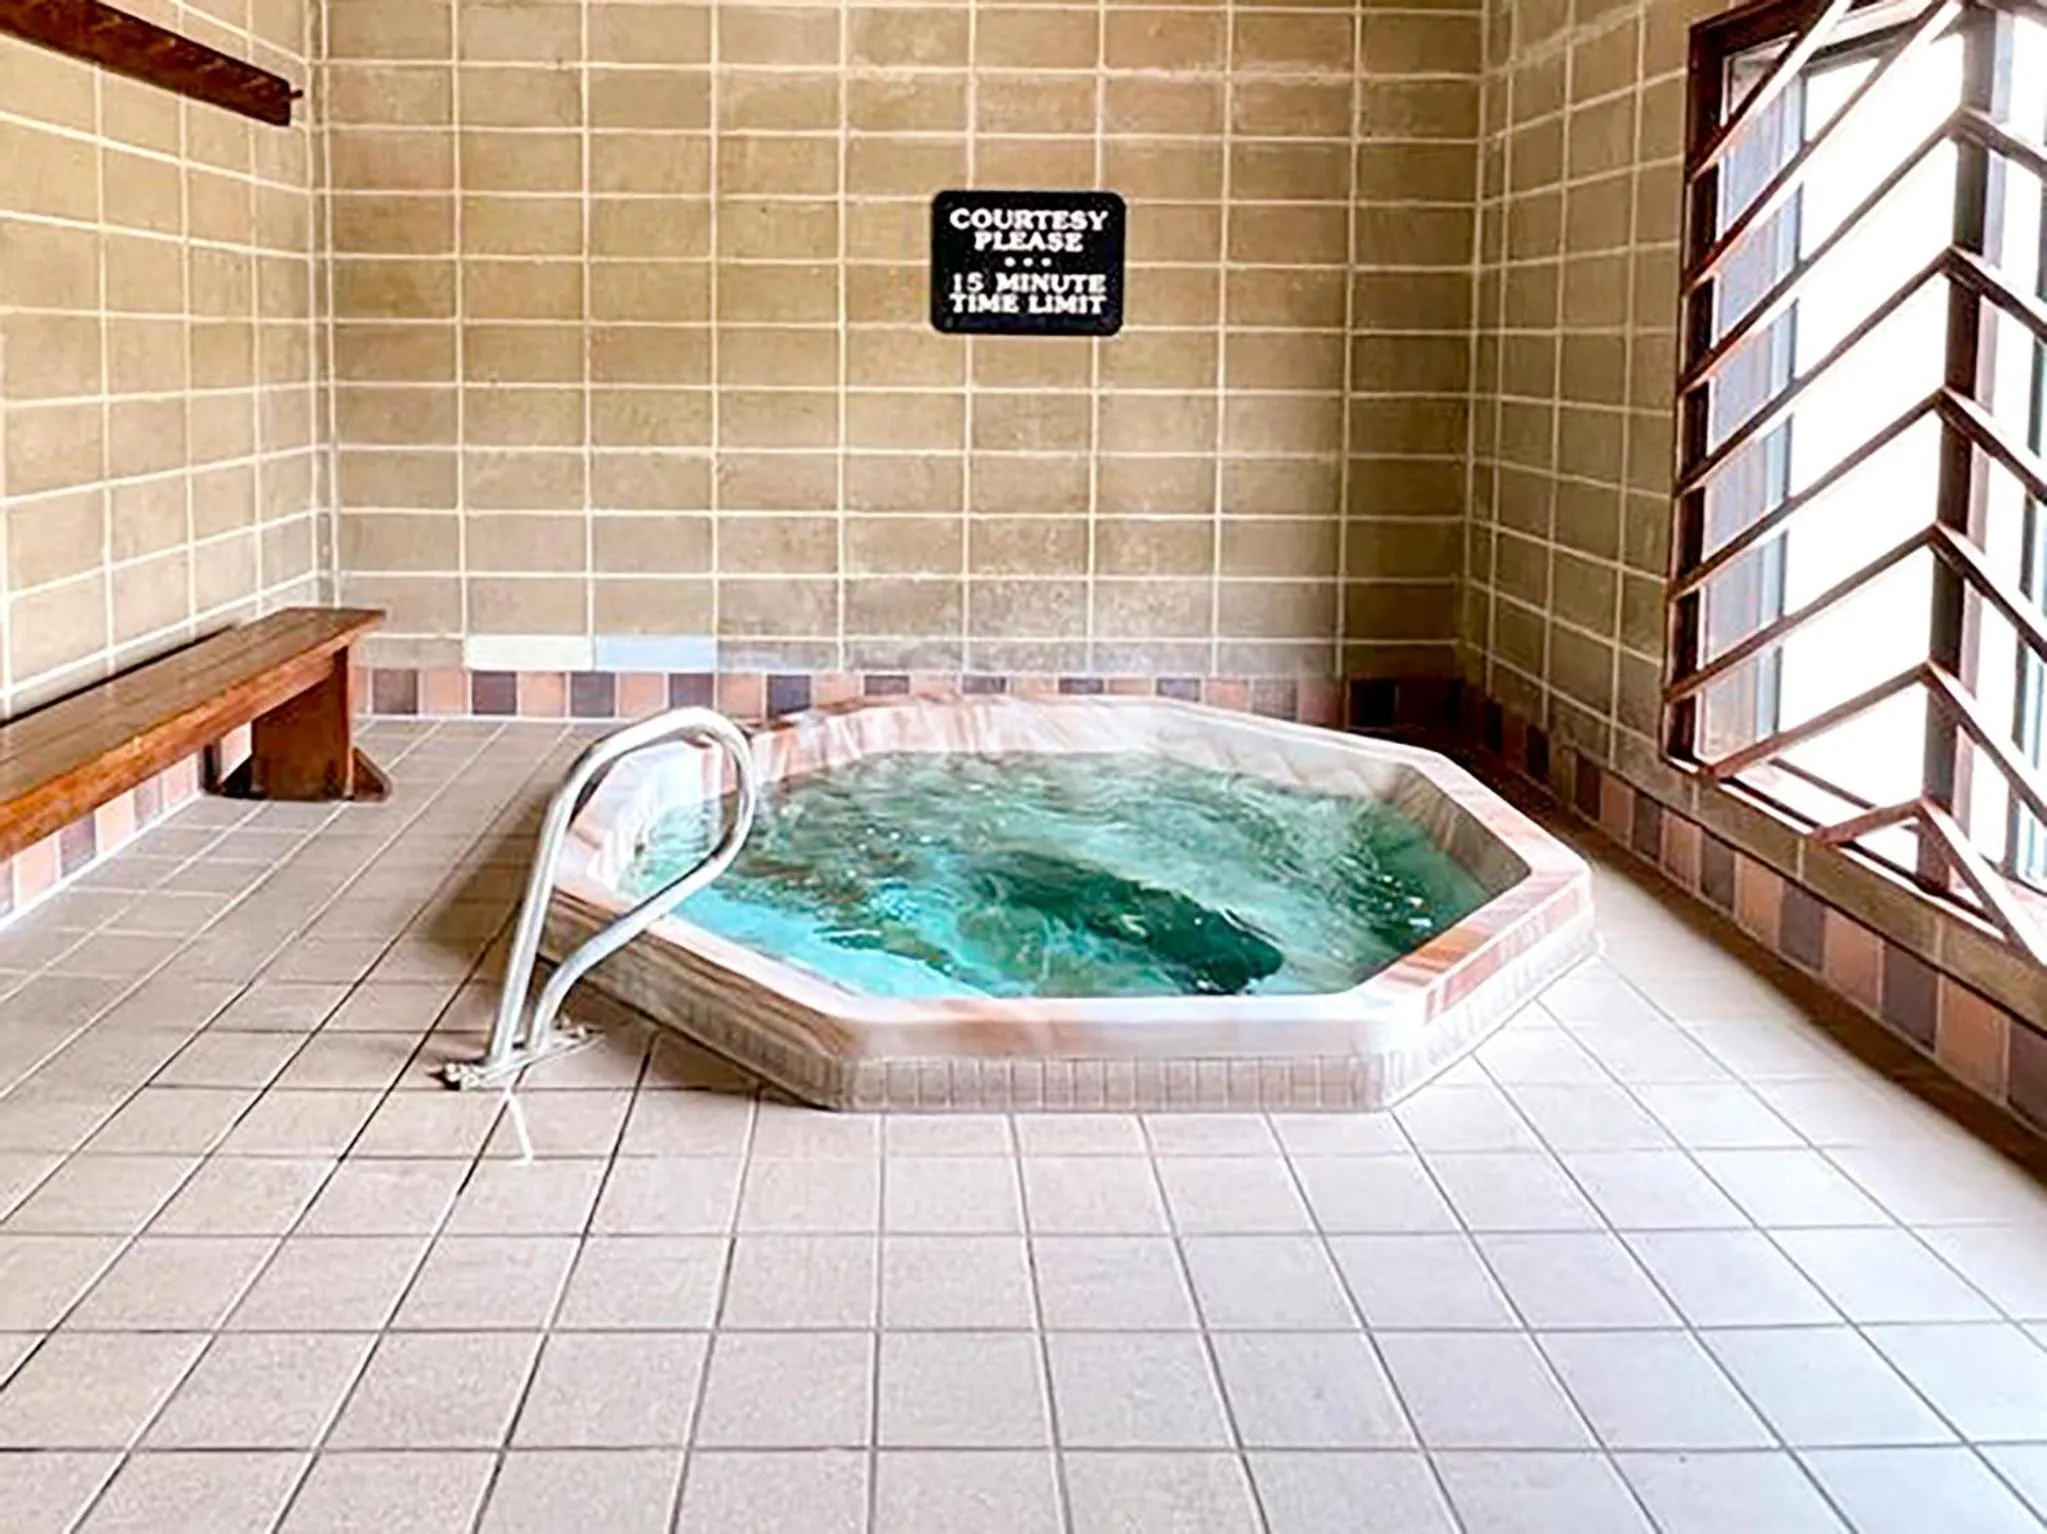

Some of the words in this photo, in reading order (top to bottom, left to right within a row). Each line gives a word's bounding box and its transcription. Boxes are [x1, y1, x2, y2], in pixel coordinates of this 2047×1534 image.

[949, 207, 1108, 231] COURTESY
[974, 231, 1083, 252] PLEASE
[953, 272, 984, 293] 15
[995, 272, 1107, 294] MINUTE
[949, 293, 1019, 313] TIME
[1028, 294, 1107, 314] LIMIT
